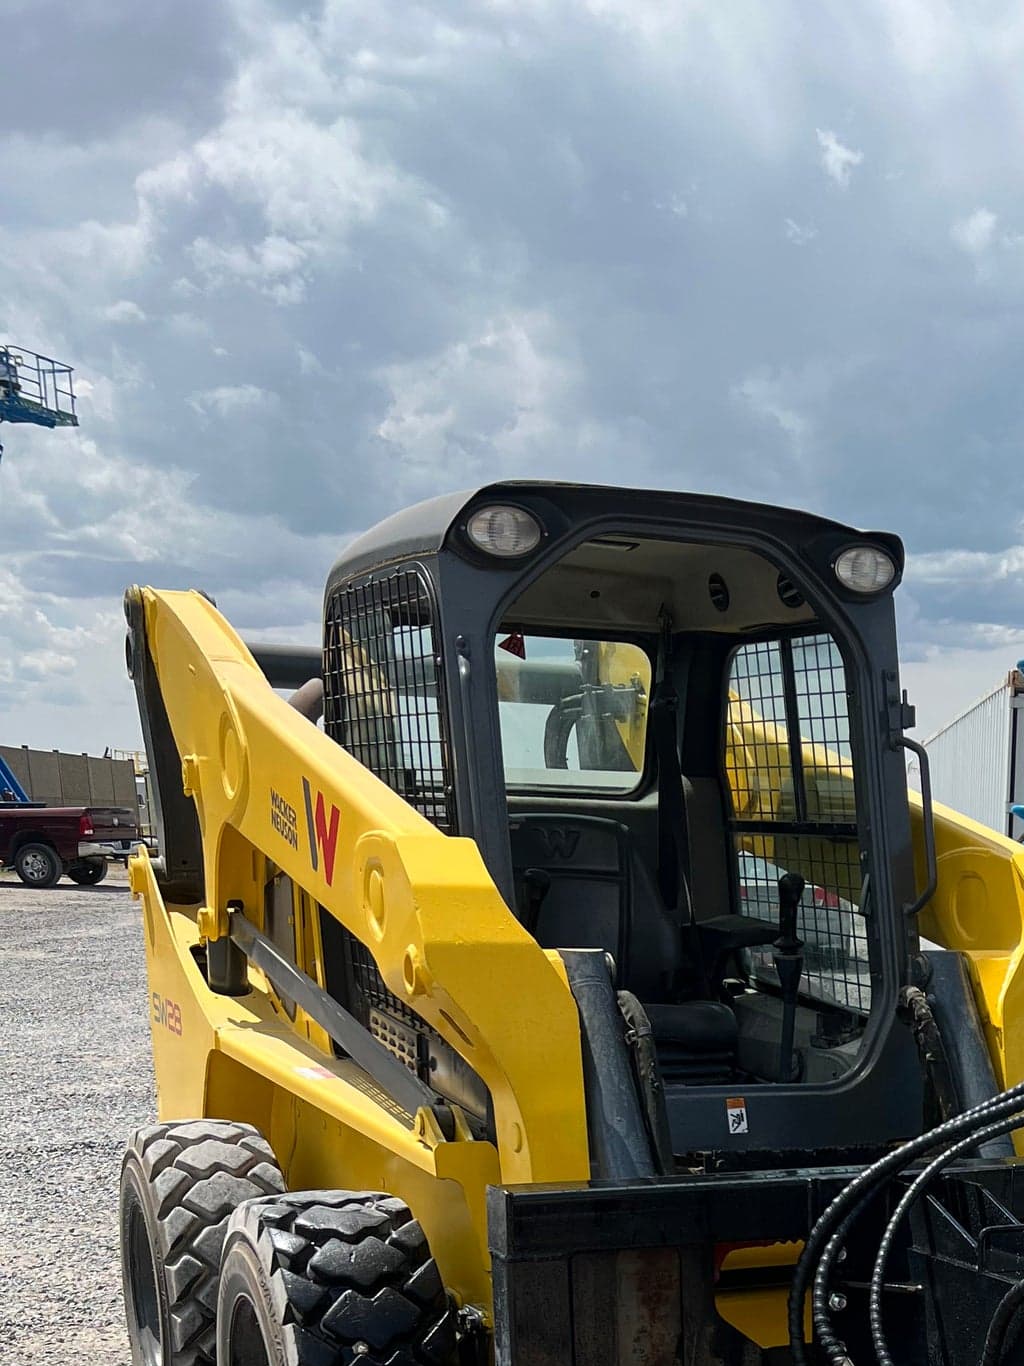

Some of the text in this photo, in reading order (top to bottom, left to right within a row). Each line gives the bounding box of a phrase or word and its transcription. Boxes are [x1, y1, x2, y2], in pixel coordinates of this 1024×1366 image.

[270, 787, 297, 831] WACKER
[271, 808, 298, 852] NEUSON
[152, 992, 182, 1037] SW28
